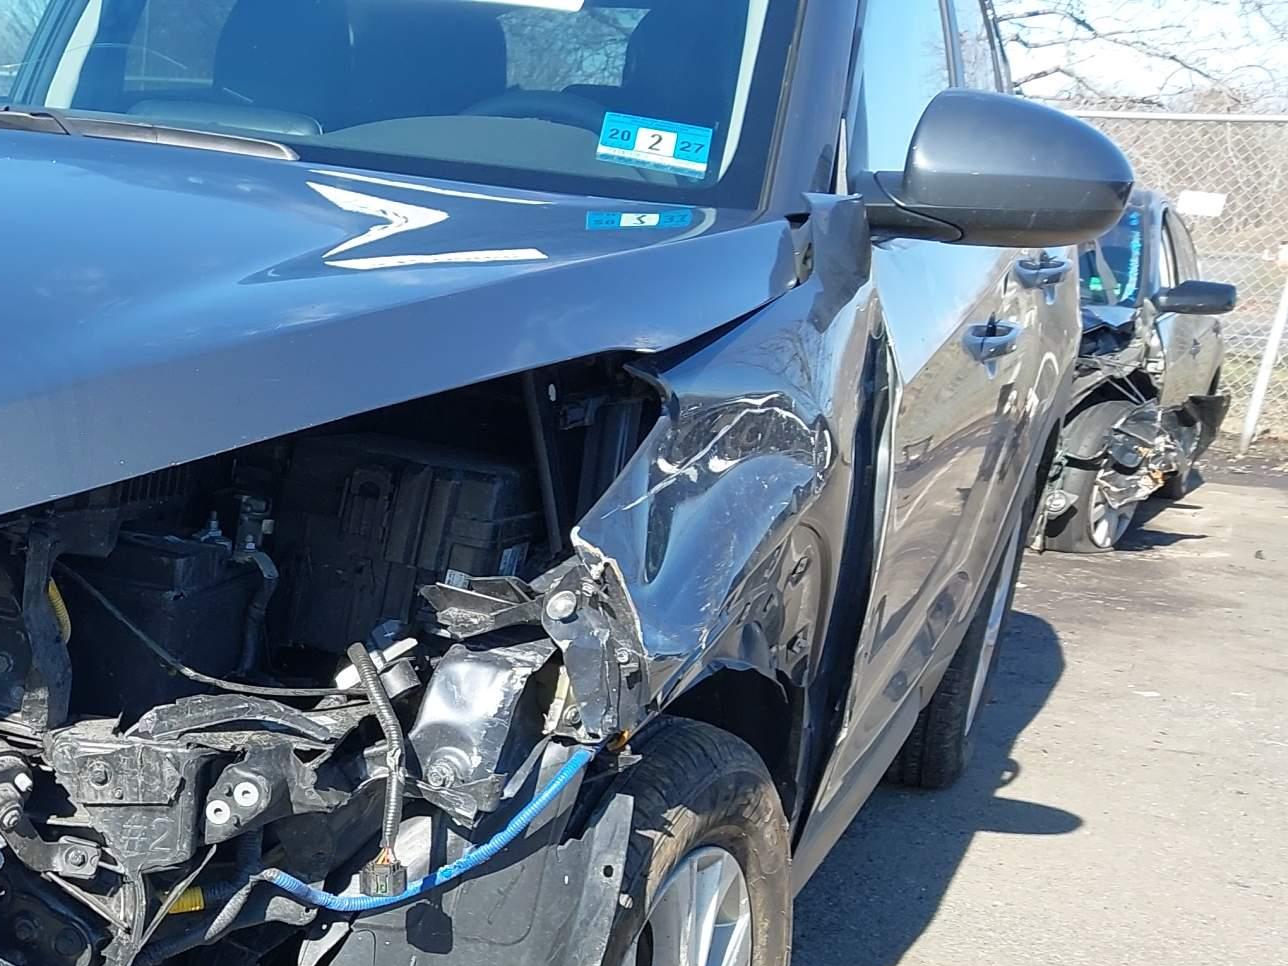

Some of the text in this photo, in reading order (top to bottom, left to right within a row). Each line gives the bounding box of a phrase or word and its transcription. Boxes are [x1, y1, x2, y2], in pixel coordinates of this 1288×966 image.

[609, 128, 705, 154] 20 2 27
[121, 816, 175, 853] #2
